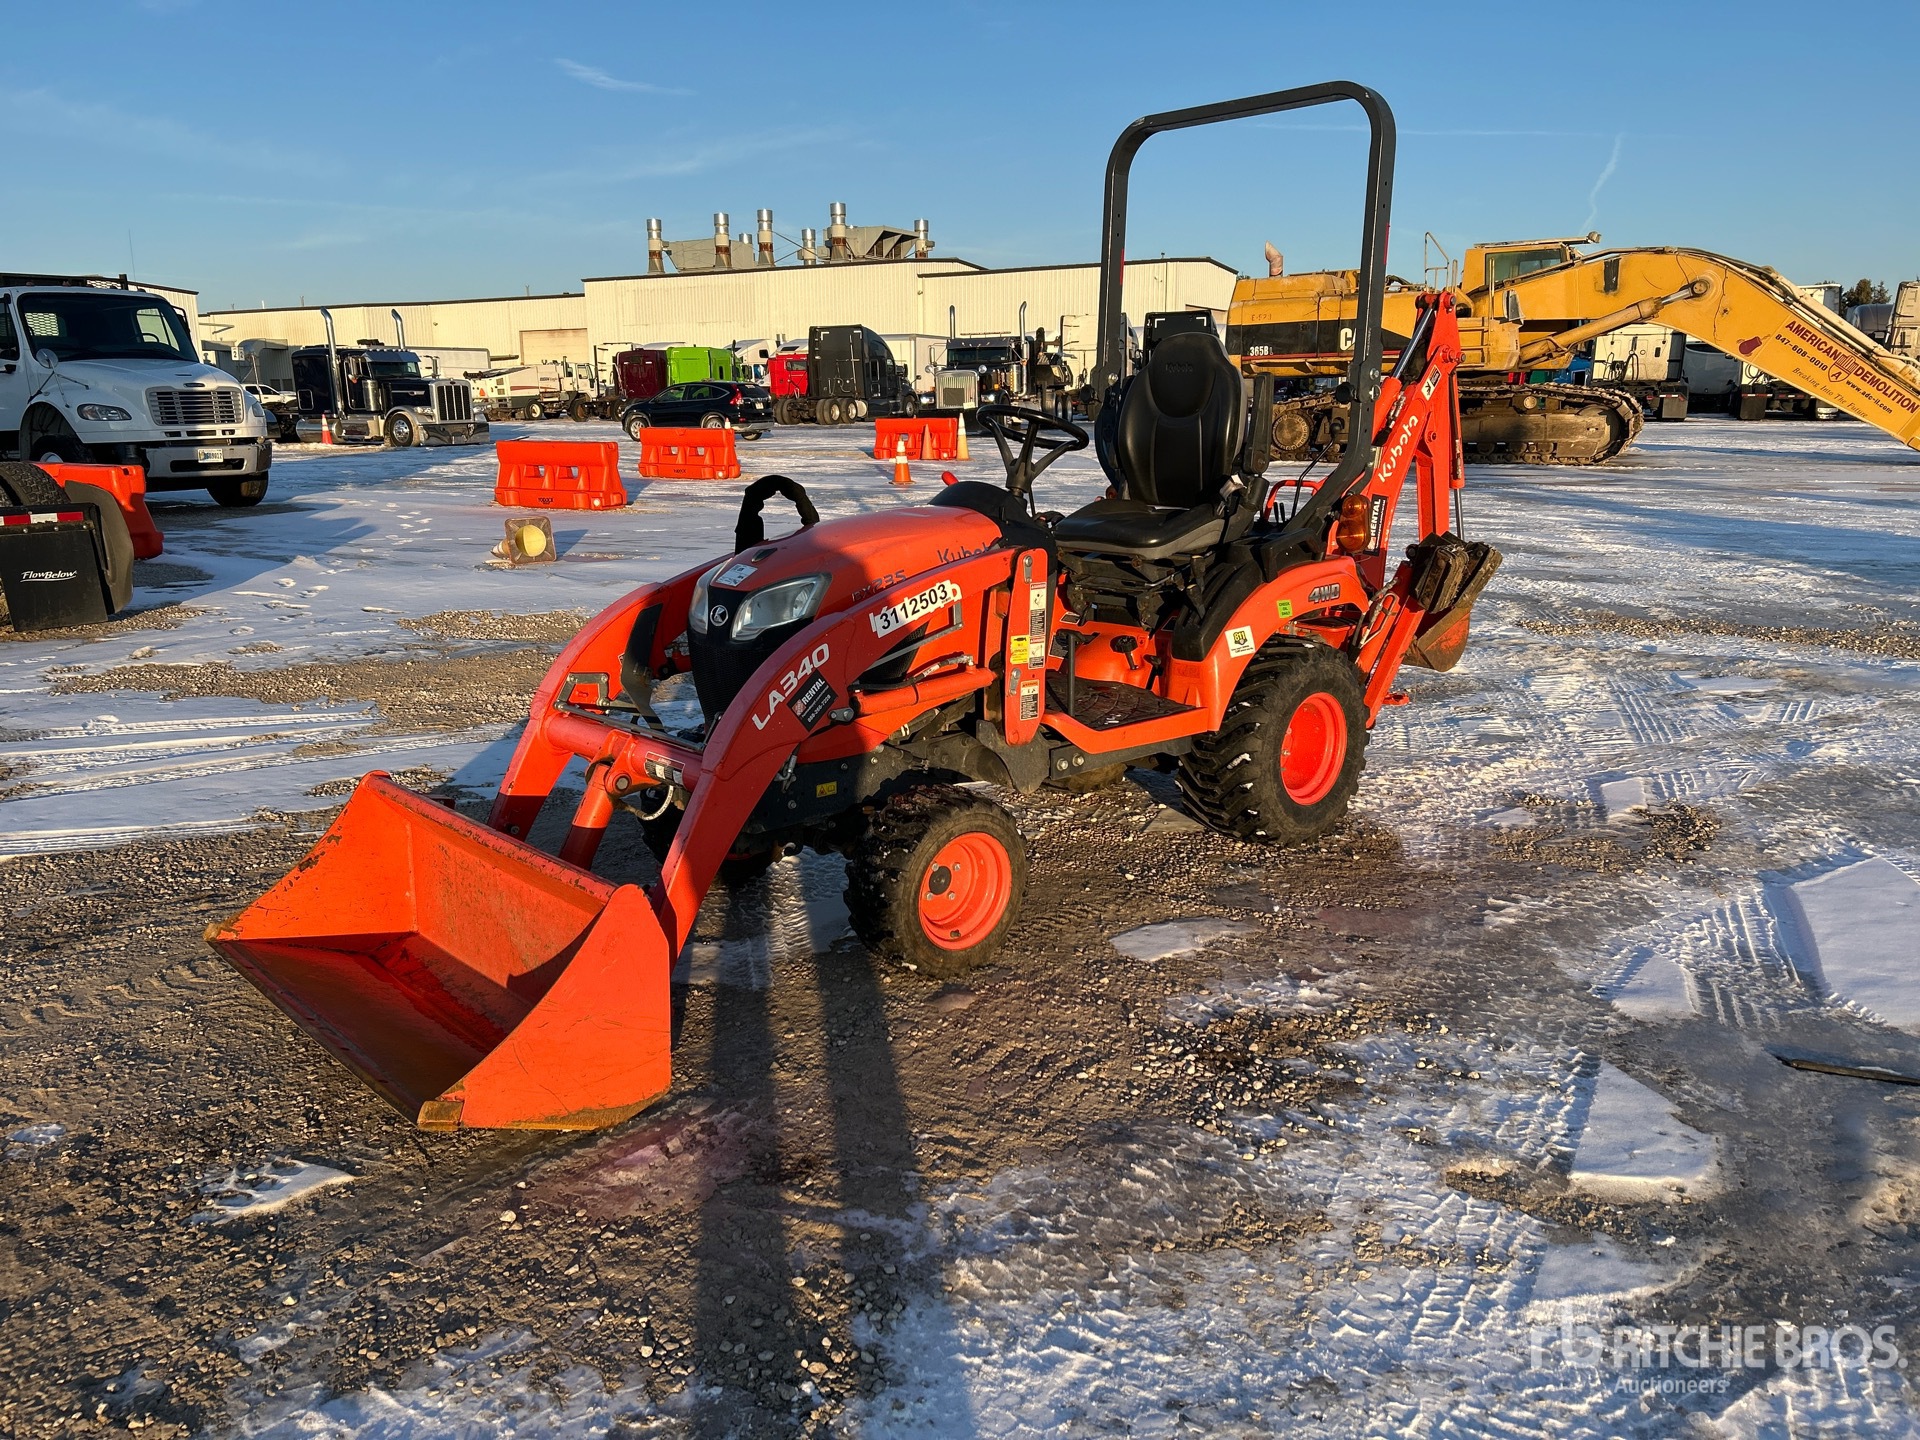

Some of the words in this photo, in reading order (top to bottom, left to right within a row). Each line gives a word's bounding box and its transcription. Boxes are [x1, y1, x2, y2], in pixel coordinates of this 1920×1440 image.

[1785, 320, 1841, 361] AMERICAN
[1853, 366, 1920, 414] DEMOLITION
[1792, 367, 1821, 388] Breaking
[1820, 385, 1834, 397] Into
[1834, 393, 1847, 405] The
[1847, 401, 1869, 418] Future
[1845, 379, 1893, 415] www.adc-il.com
[1378, 415, 1418, 483] Kubota
[1370, 499, 1382, 537] RENTAL
[21, 570, 77, 580] FlowBelow
[1308, 583, 1341, 604] 4WD
[879, 584, 949, 630] 3112503
[1233, 630, 1247, 642] 811
[752, 643, 830, 730] LA340
[801, 678, 826, 705] RENTAL
